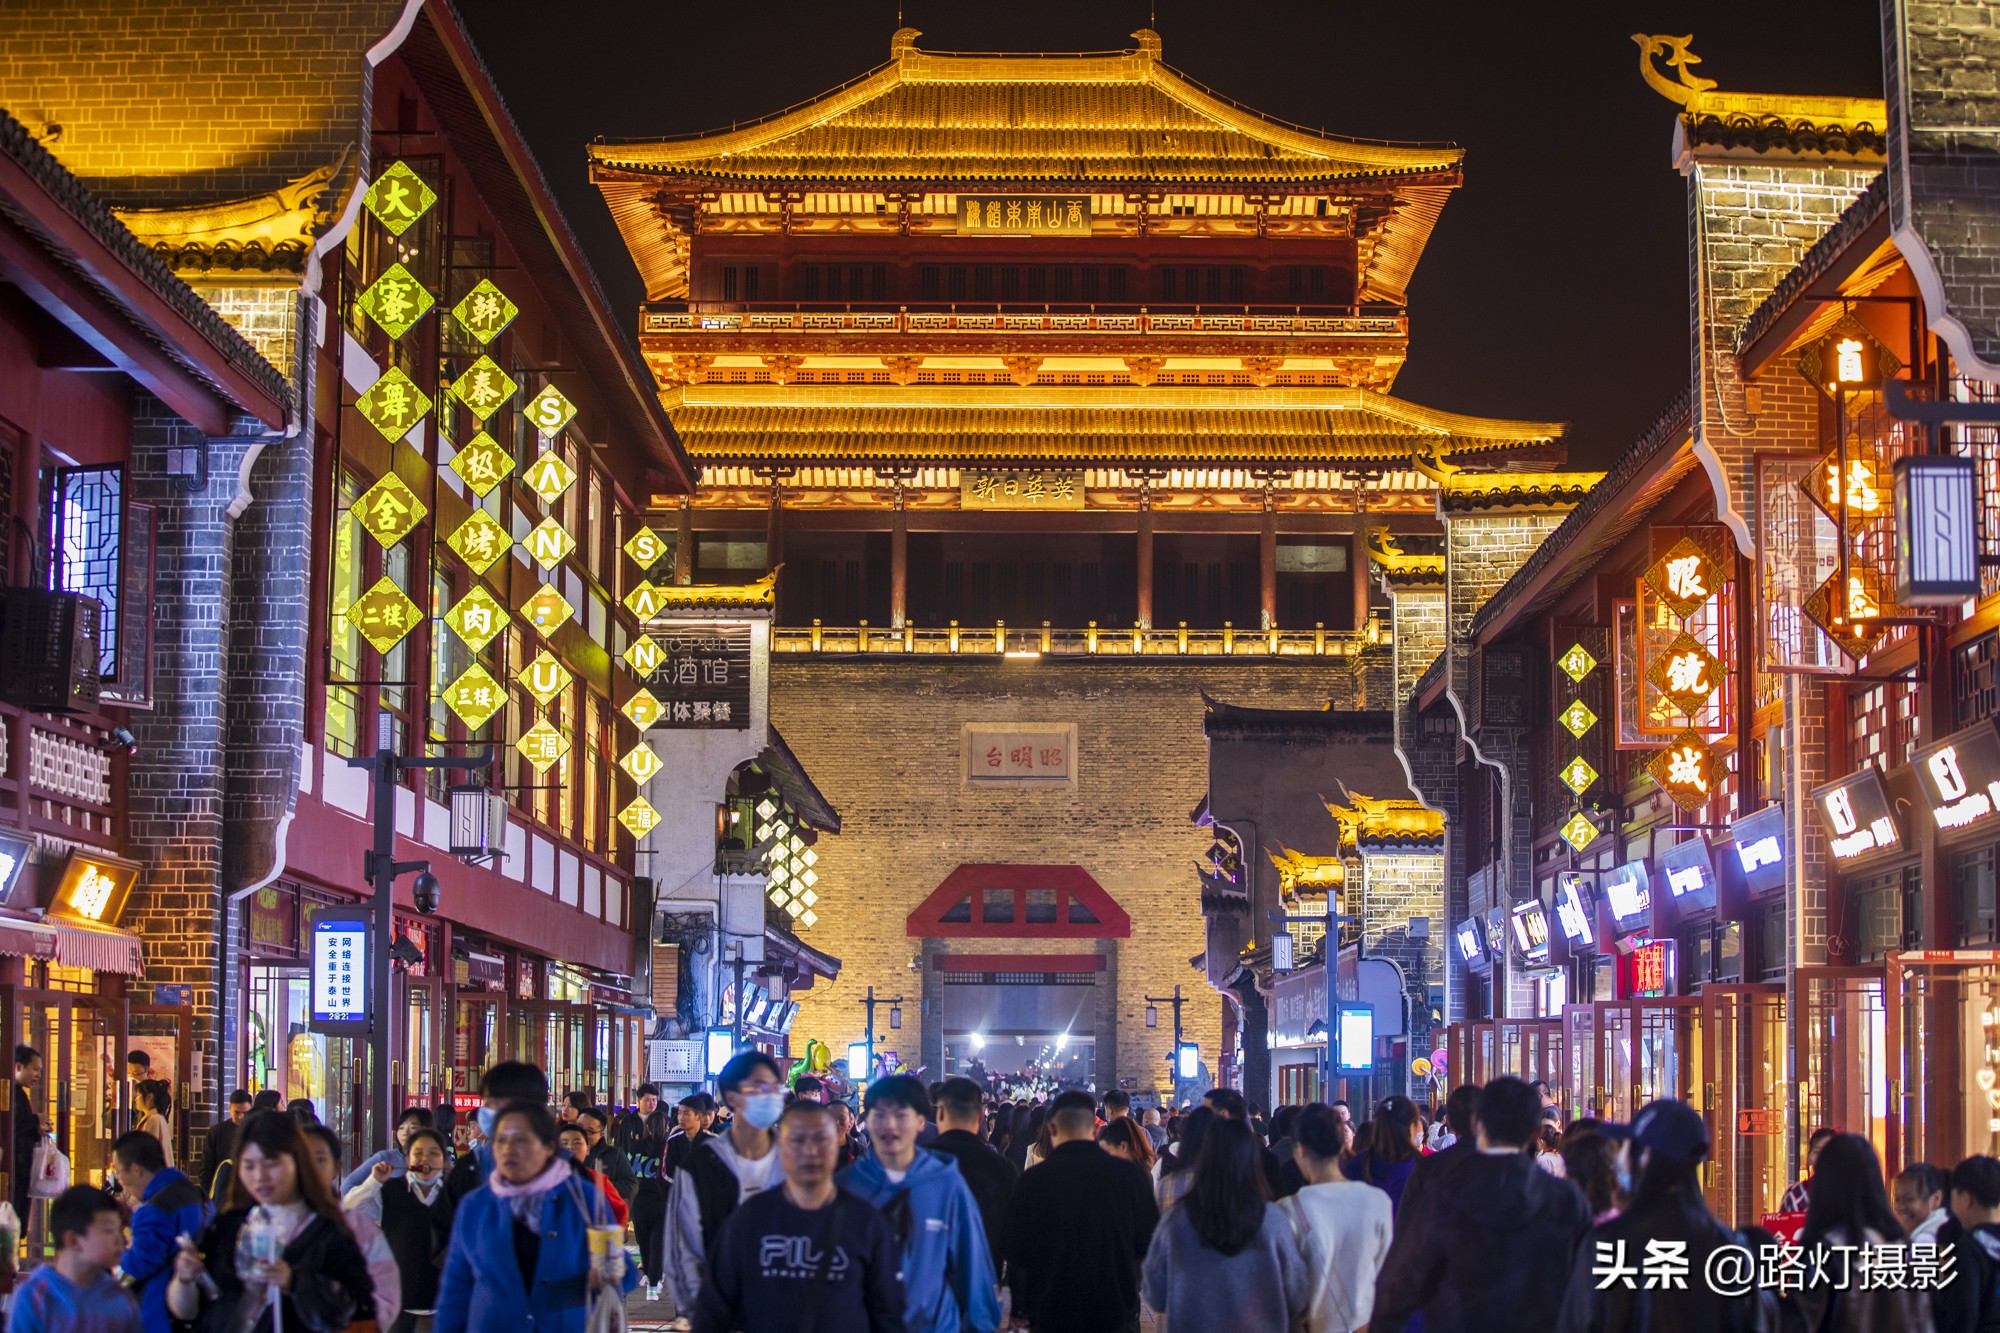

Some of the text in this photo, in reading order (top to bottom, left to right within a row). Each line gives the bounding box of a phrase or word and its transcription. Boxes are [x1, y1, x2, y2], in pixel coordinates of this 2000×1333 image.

[328, 937, 337, 1007] 安全重于泰山
[342, 937, 351, 1007] 网络连接世界
